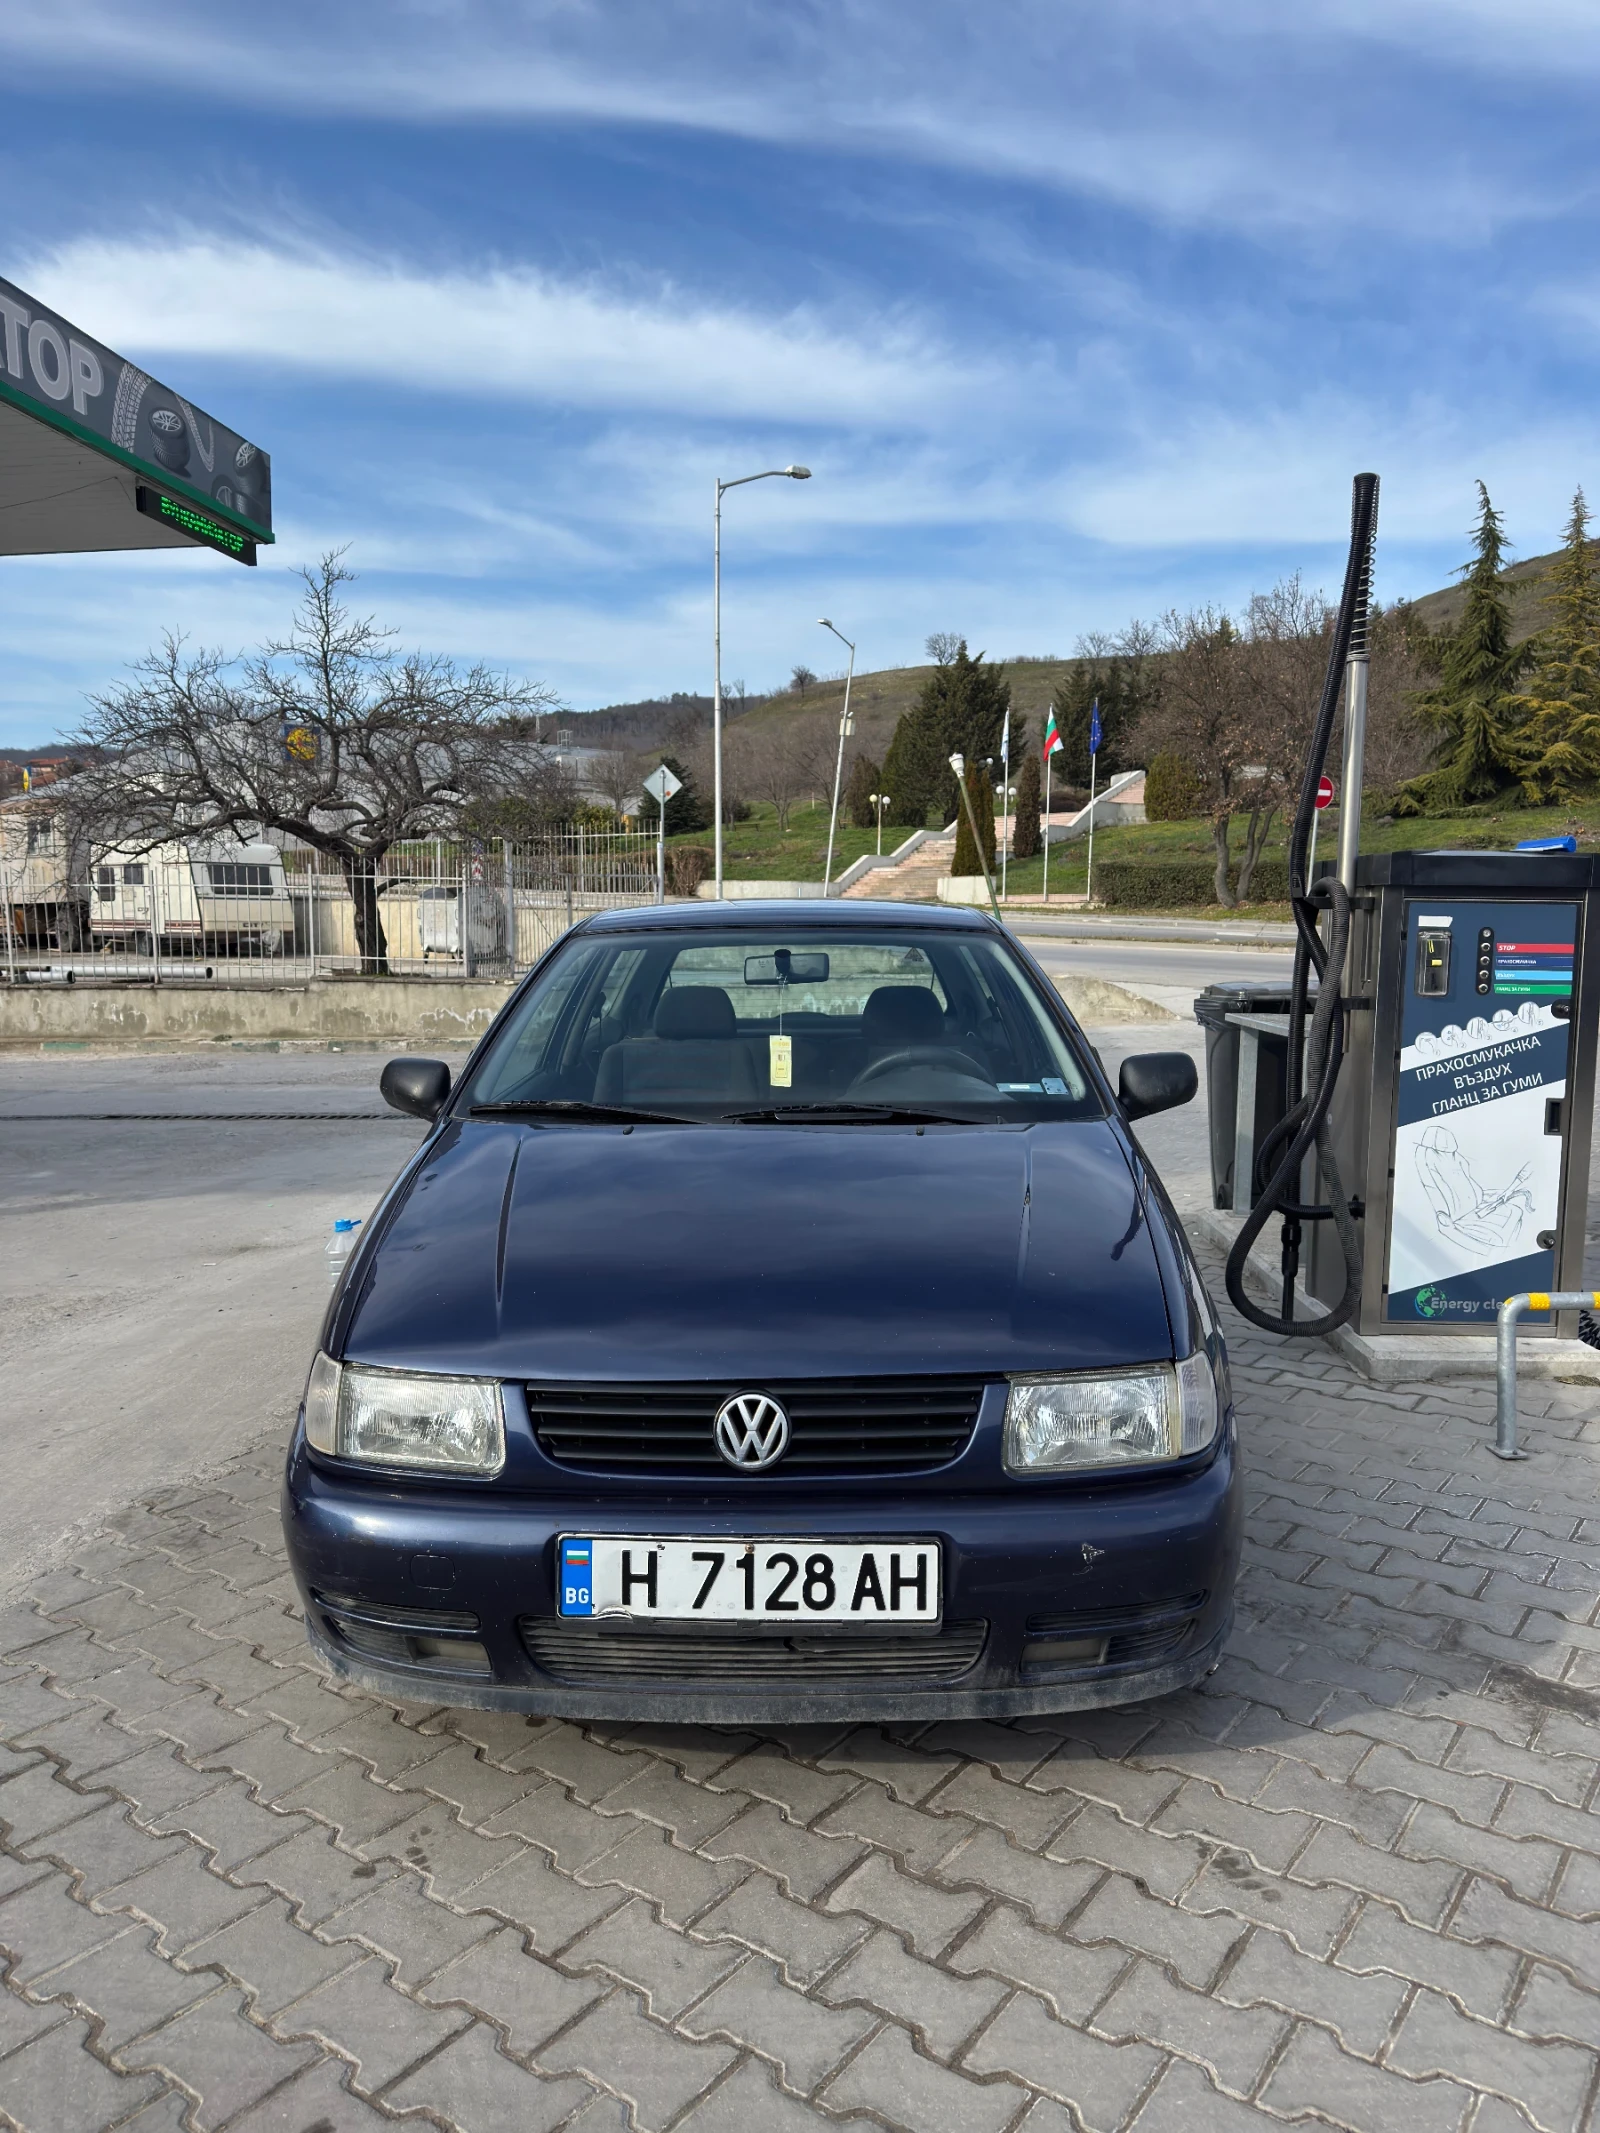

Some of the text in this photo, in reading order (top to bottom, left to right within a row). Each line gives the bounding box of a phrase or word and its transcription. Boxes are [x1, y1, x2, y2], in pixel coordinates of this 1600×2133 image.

[1415, 1035, 1541, 1081] ПРАХОСМУКАЧКА
[1432, 1072, 1543, 1114] ГЛАНЦ ЗА ГУМИ
[1453, 1063, 1512, 1089] ВЪЗДУХ
[1431, 1297, 1505, 1313] Energy cle
[565, 1587, 589, 1604] BG
[621, 1549, 927, 1611] H 7128 AH
